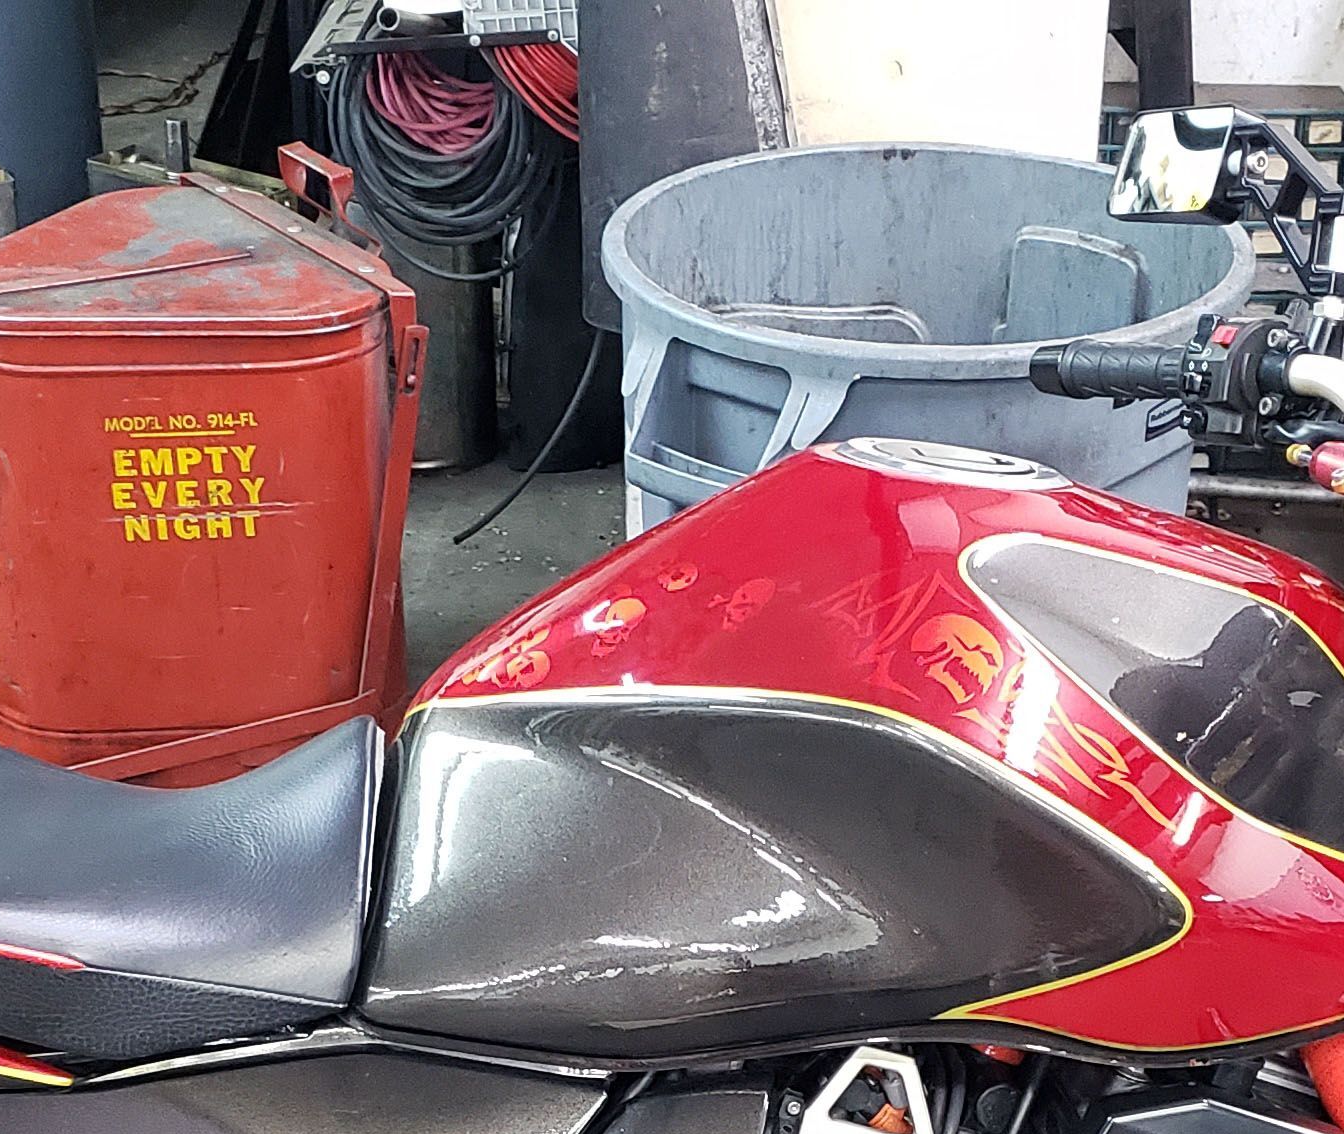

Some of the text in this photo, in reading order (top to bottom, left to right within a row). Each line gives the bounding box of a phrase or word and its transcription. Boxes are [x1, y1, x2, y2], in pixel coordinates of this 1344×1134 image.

[105, 412, 258, 432] MODEL NO. 914-FL
[113, 445, 257, 477] EMPTY
[111, 477, 265, 510] EVERY
[124, 510, 260, 541] NIGHT
